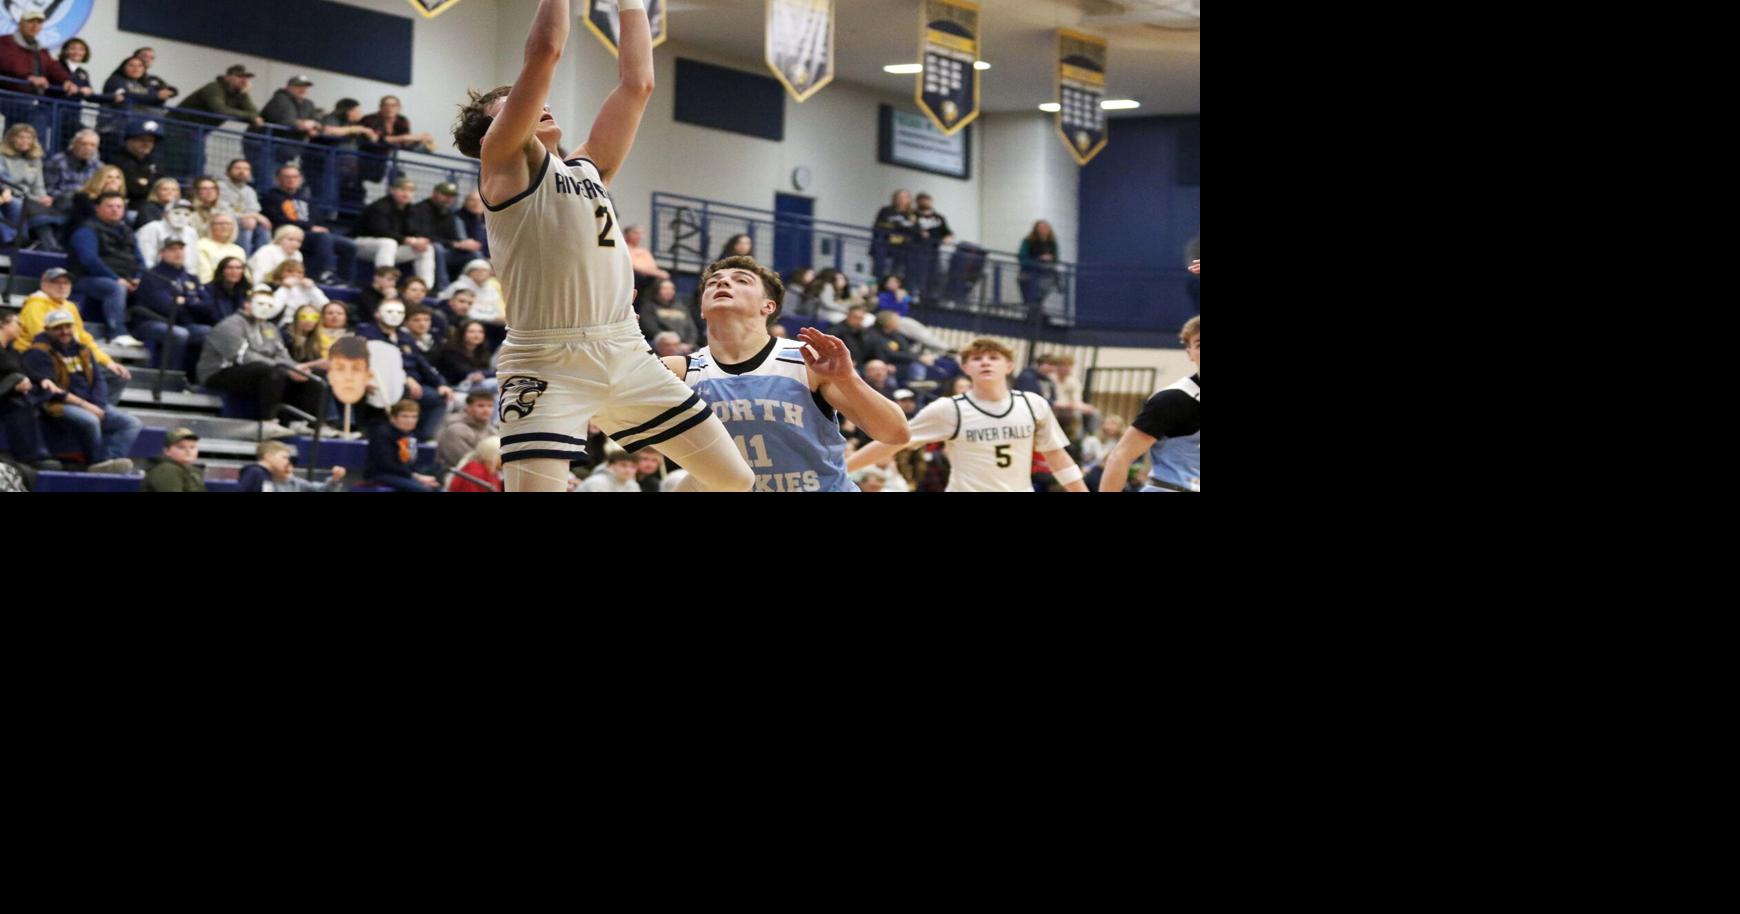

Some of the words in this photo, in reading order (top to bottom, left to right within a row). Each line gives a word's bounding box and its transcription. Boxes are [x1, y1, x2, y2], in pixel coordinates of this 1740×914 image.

[595, 205, 615, 247] 2
[710, 398, 804, 429] ORTH
[966, 427, 999, 442] RIVER
[995, 444, 1012, 468] 5
[752, 470, 821, 492] KIES
